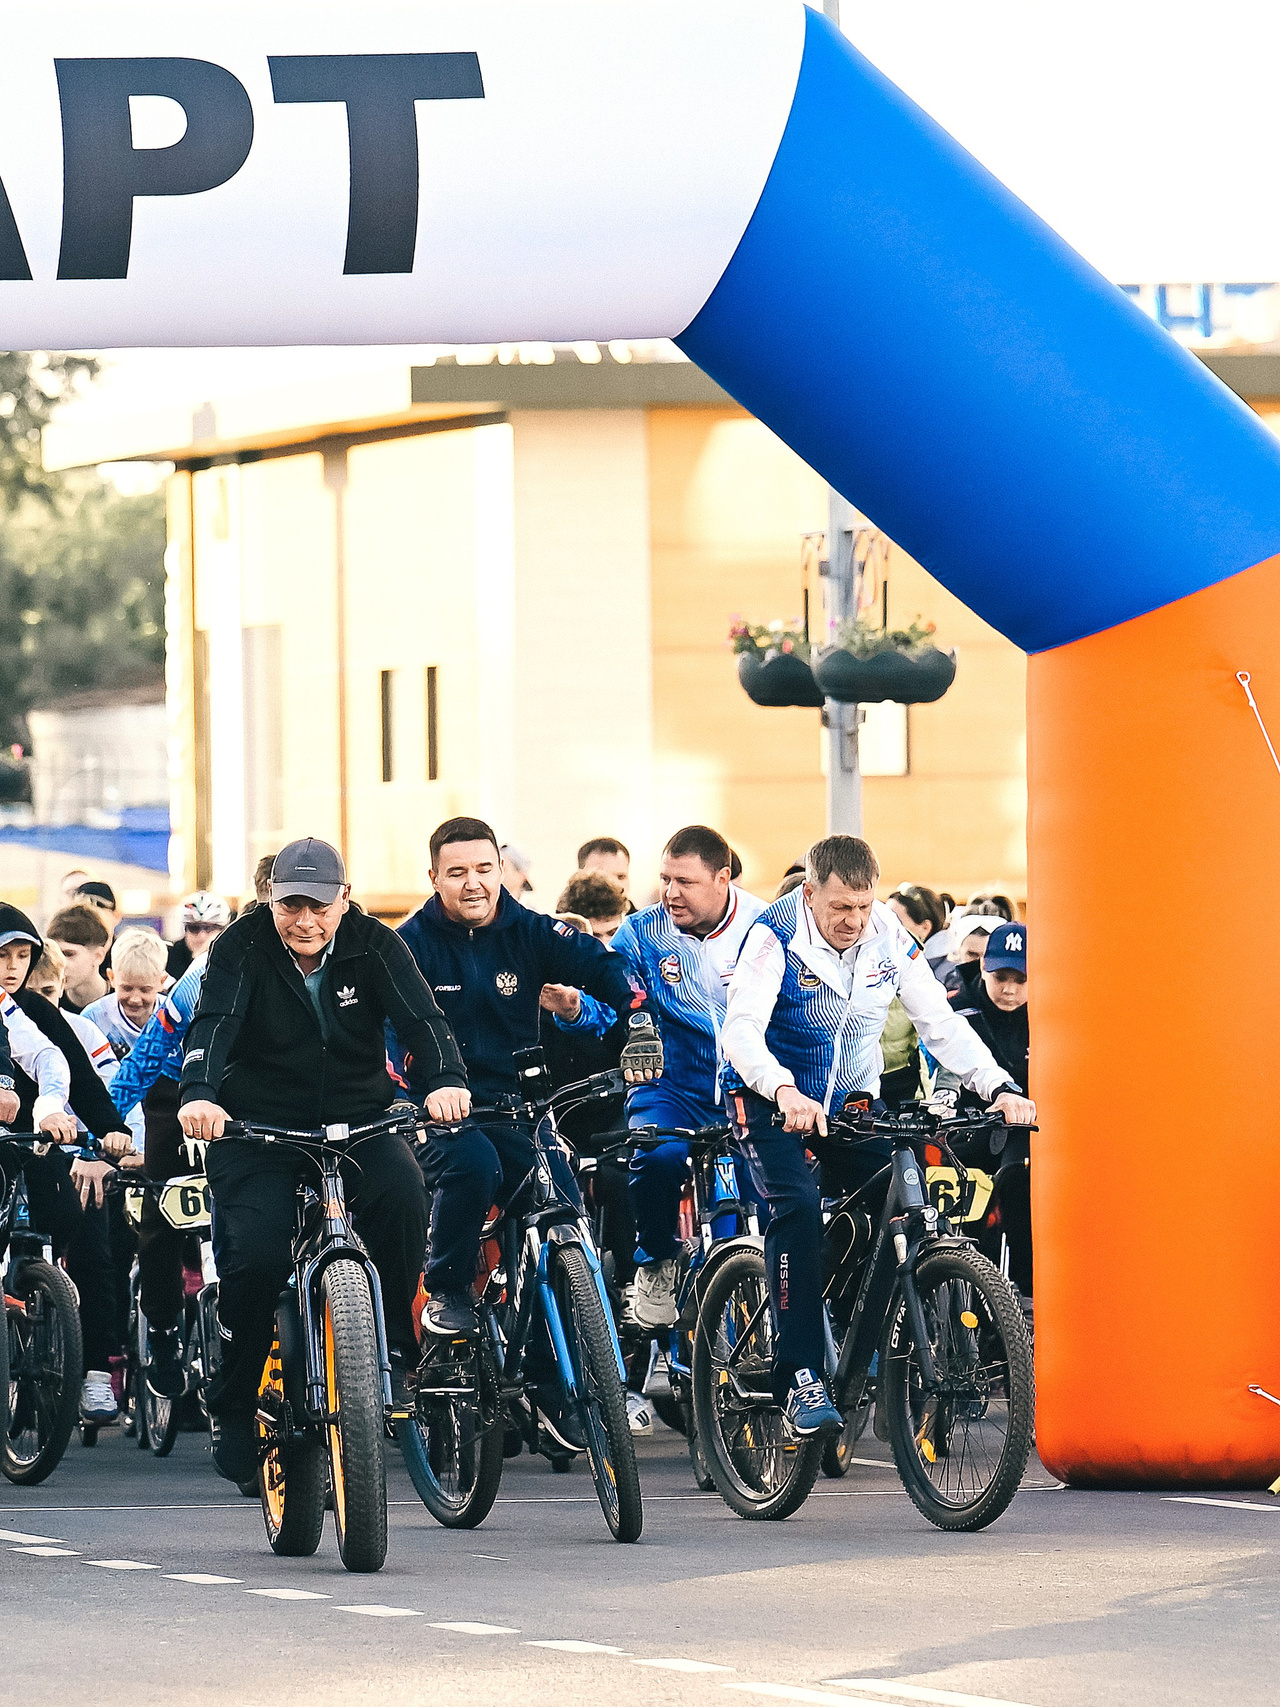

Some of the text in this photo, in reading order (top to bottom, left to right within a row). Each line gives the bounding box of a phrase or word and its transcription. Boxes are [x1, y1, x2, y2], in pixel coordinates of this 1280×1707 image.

[340, 998, 359, 1008] adidas
[780, 1253, 789, 1310] RUSSIA
[890, 1322, 901, 1349] CST
